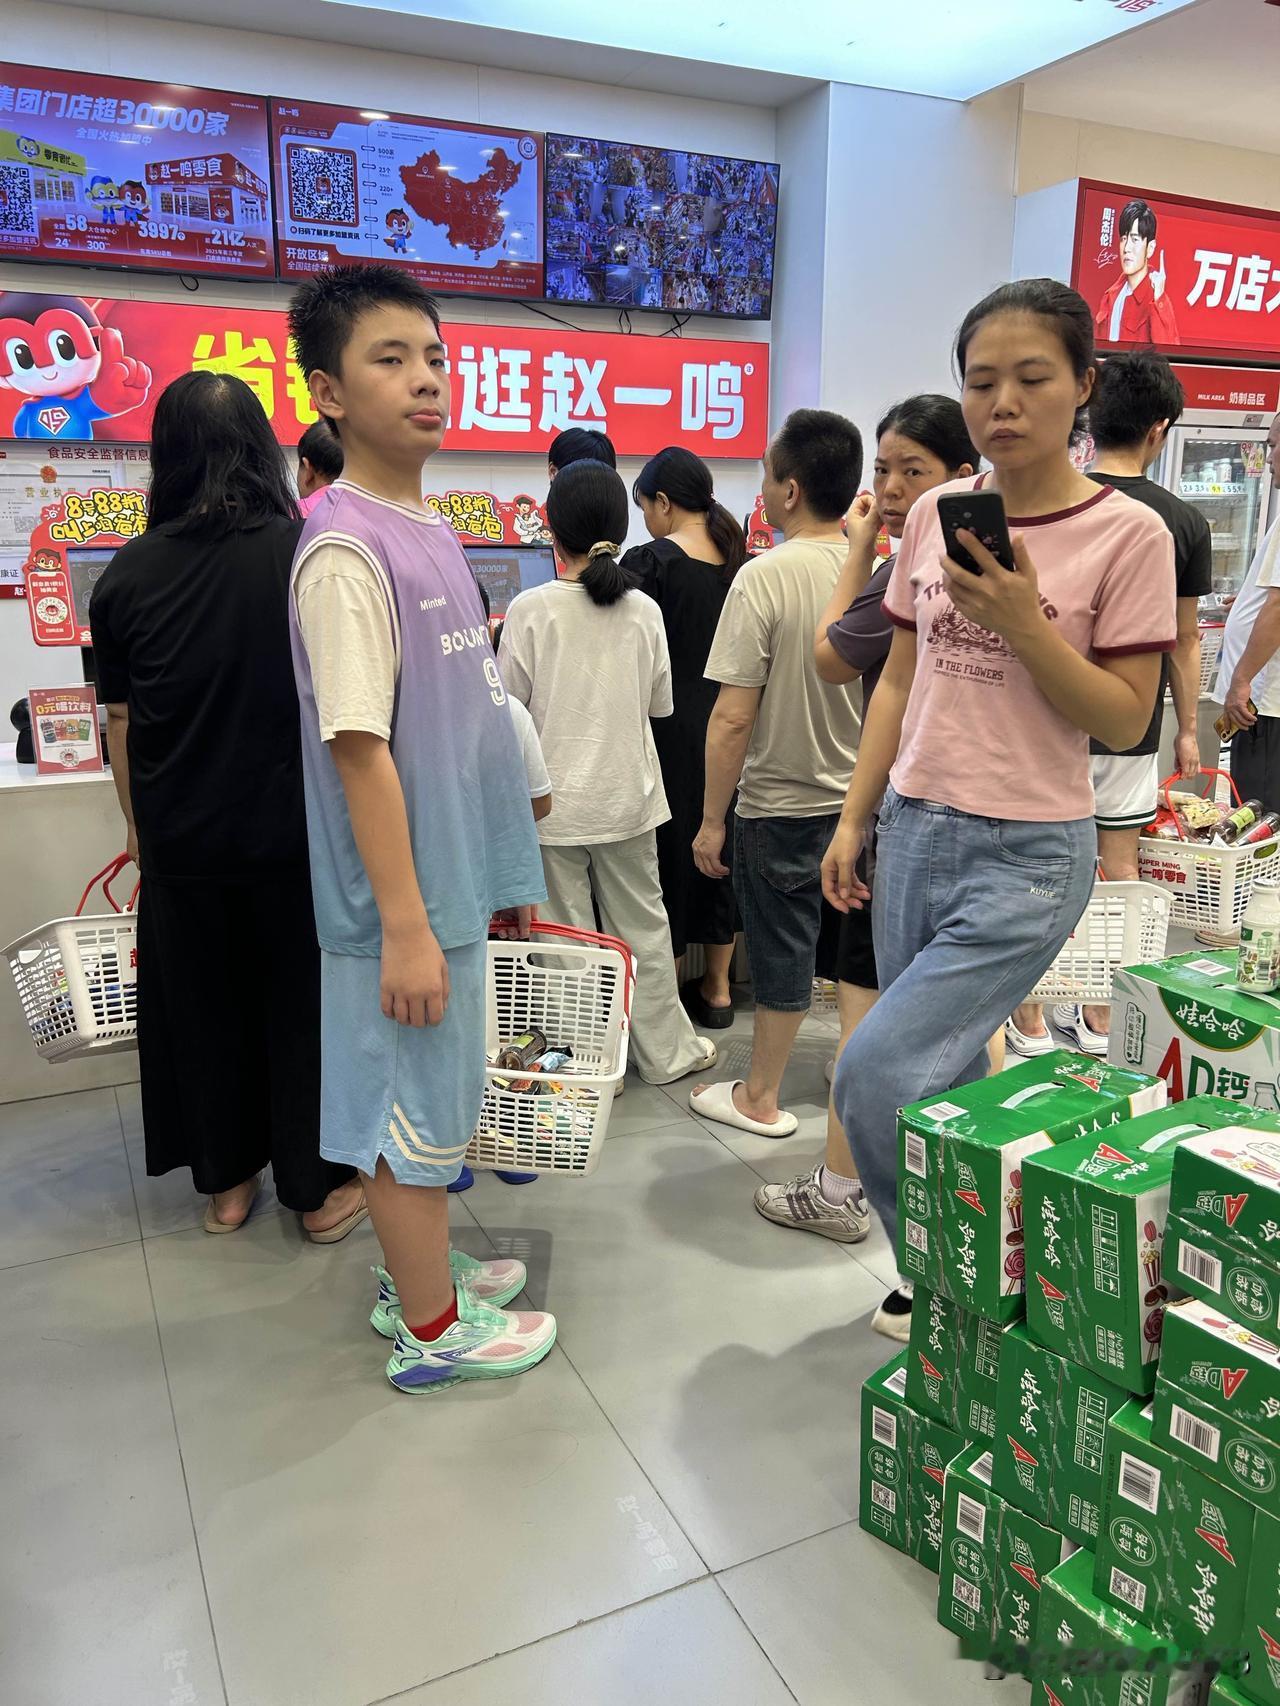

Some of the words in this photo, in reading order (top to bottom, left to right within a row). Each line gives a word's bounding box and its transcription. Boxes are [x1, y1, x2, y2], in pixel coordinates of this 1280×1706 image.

[160, 158, 223, 178] 赵一鸣零食
[1228, 391, 1266, 406] 奶制品区
[48, 446, 149, 461] 食品安全监督信息
[420, 595, 447, 611] Minted
[935, 658, 944, 668] IN
[945, 660, 962, 673] THE
[964, 664, 1004, 681] FLOWERS
[483, 657, 506, 706] 9
[1176, 1001, 1245, 1040] 娃哈哈
[1041, 1196, 1061, 1267] 娃哈哈
[1019, 1367, 1042, 1434] 娃哈哈
